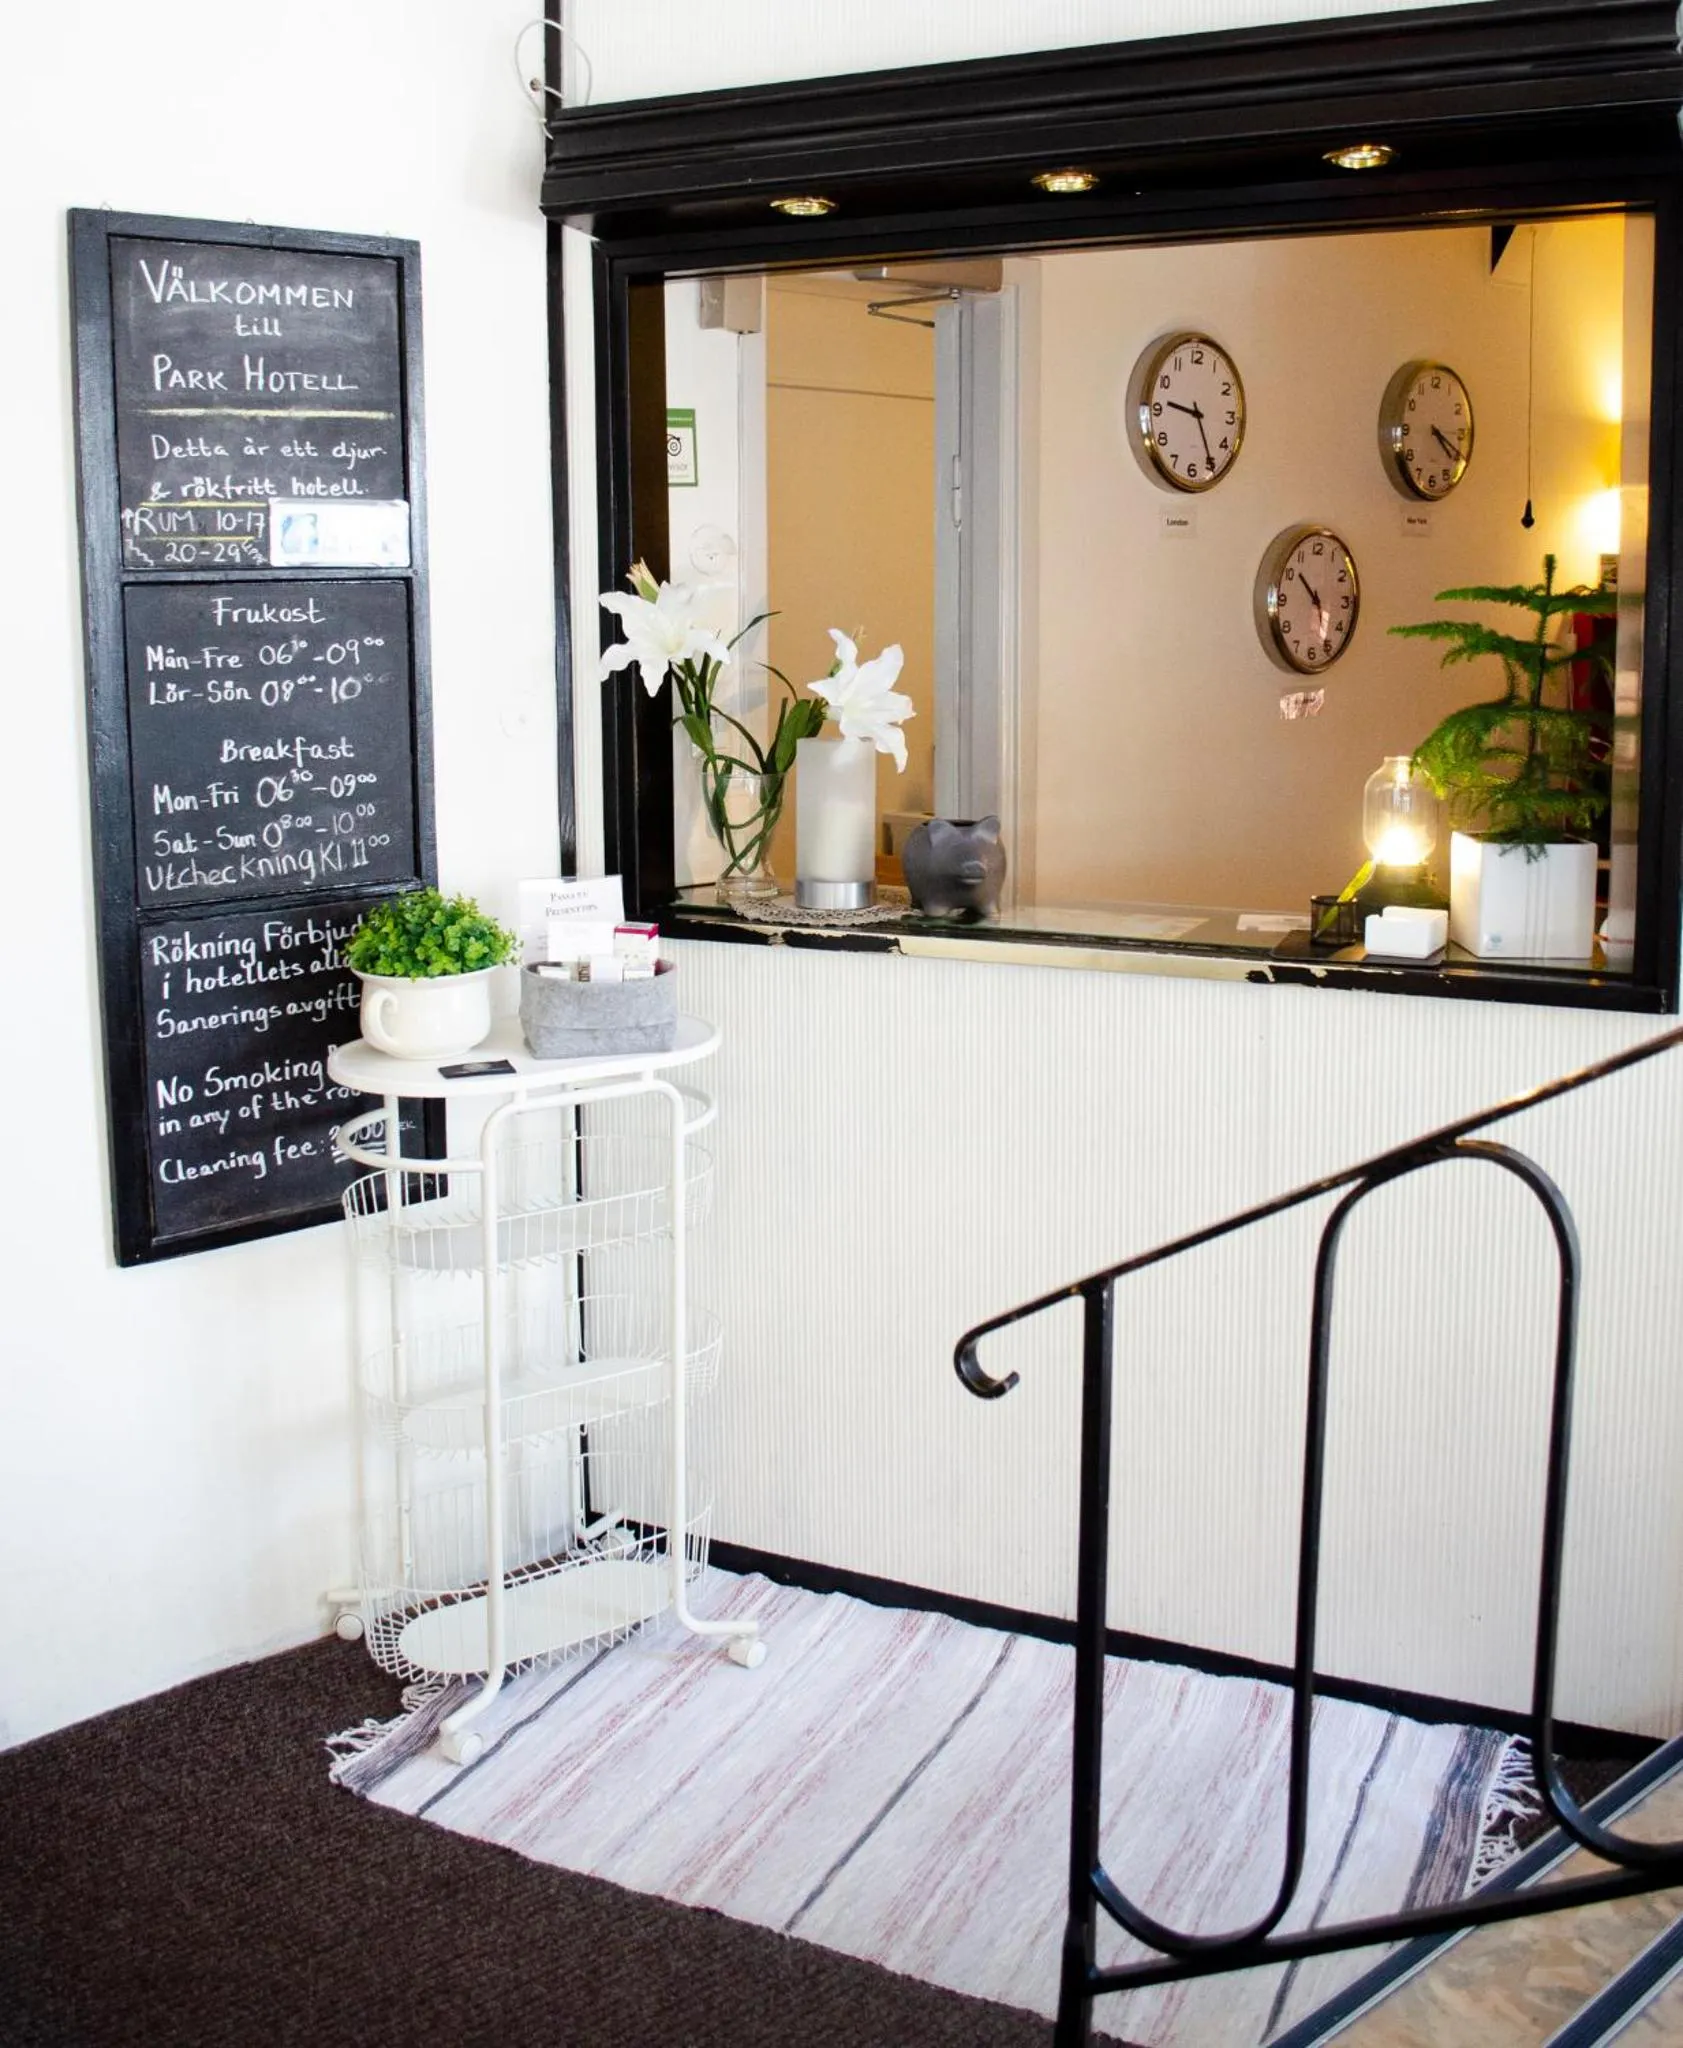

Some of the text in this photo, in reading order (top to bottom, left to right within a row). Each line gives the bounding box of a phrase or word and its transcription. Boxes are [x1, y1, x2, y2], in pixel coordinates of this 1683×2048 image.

[139, 259, 354, 309] VÄLKOMMEN
[234, 313, 282, 337] till
[1173, 357, 1182, 372] 11
[1190, 350, 1204, 365] 12
[152, 353, 360, 393] PARK HOTELL
[1160, 375, 1170, 389] 10
[1221, 382, 1232, 396] 2
[1152, 402, 1162, 417] 9
[1225, 411, 1235, 425] 3
[1157, 432, 1168, 446] 8
[1219, 436, 1229, 451] 4
[151, 434, 229, 460] Detta
[280, 439, 319, 458] ett
[1170, 454, 1179, 468] 7
[1187, 463, 1197, 478] 6
[180, 475, 278, 500] rökfritt
[133, 506, 266, 538] RUM 10-17
[164, 541, 242, 564] 20-29
[1297, 550, 1304, 563] 11
[1312, 543, 1324, 556] 12
[1285, 568, 1294, 581] 10
[1338, 570, 1346, 582] 2
[1278, 593, 1287, 606] 9
[1341, 596, 1350, 609] 3
[210, 597, 327, 626] Frukost
[1282, 620, 1291, 633] 8
[1335, 620, 1343, 632] 4
[1293, 640, 1300, 653] 7
[1308, 647, 1316, 660] 6
[145, 645, 243, 671] Mån-Fre
[148, 680, 252, 705] Lör-Sön
[219, 736, 356, 767] Breakfast
[153, 782, 240, 815] Mon-Fri
[153, 825, 256, 857] Sat-Sun
[150, 915, 364, 967] Rökning Förbjud
[162, 972, 171, 1000] i
[185, 960, 305, 994] hotellets
[156, 1059, 324, 1109] No Smoking
[158, 1117, 181, 1136] in
[189, 1108, 230, 1135] any
[238, 1094, 261, 1119] of
[270, 1090, 318, 1111] the
[158, 1149, 267, 1184] Cleaning
